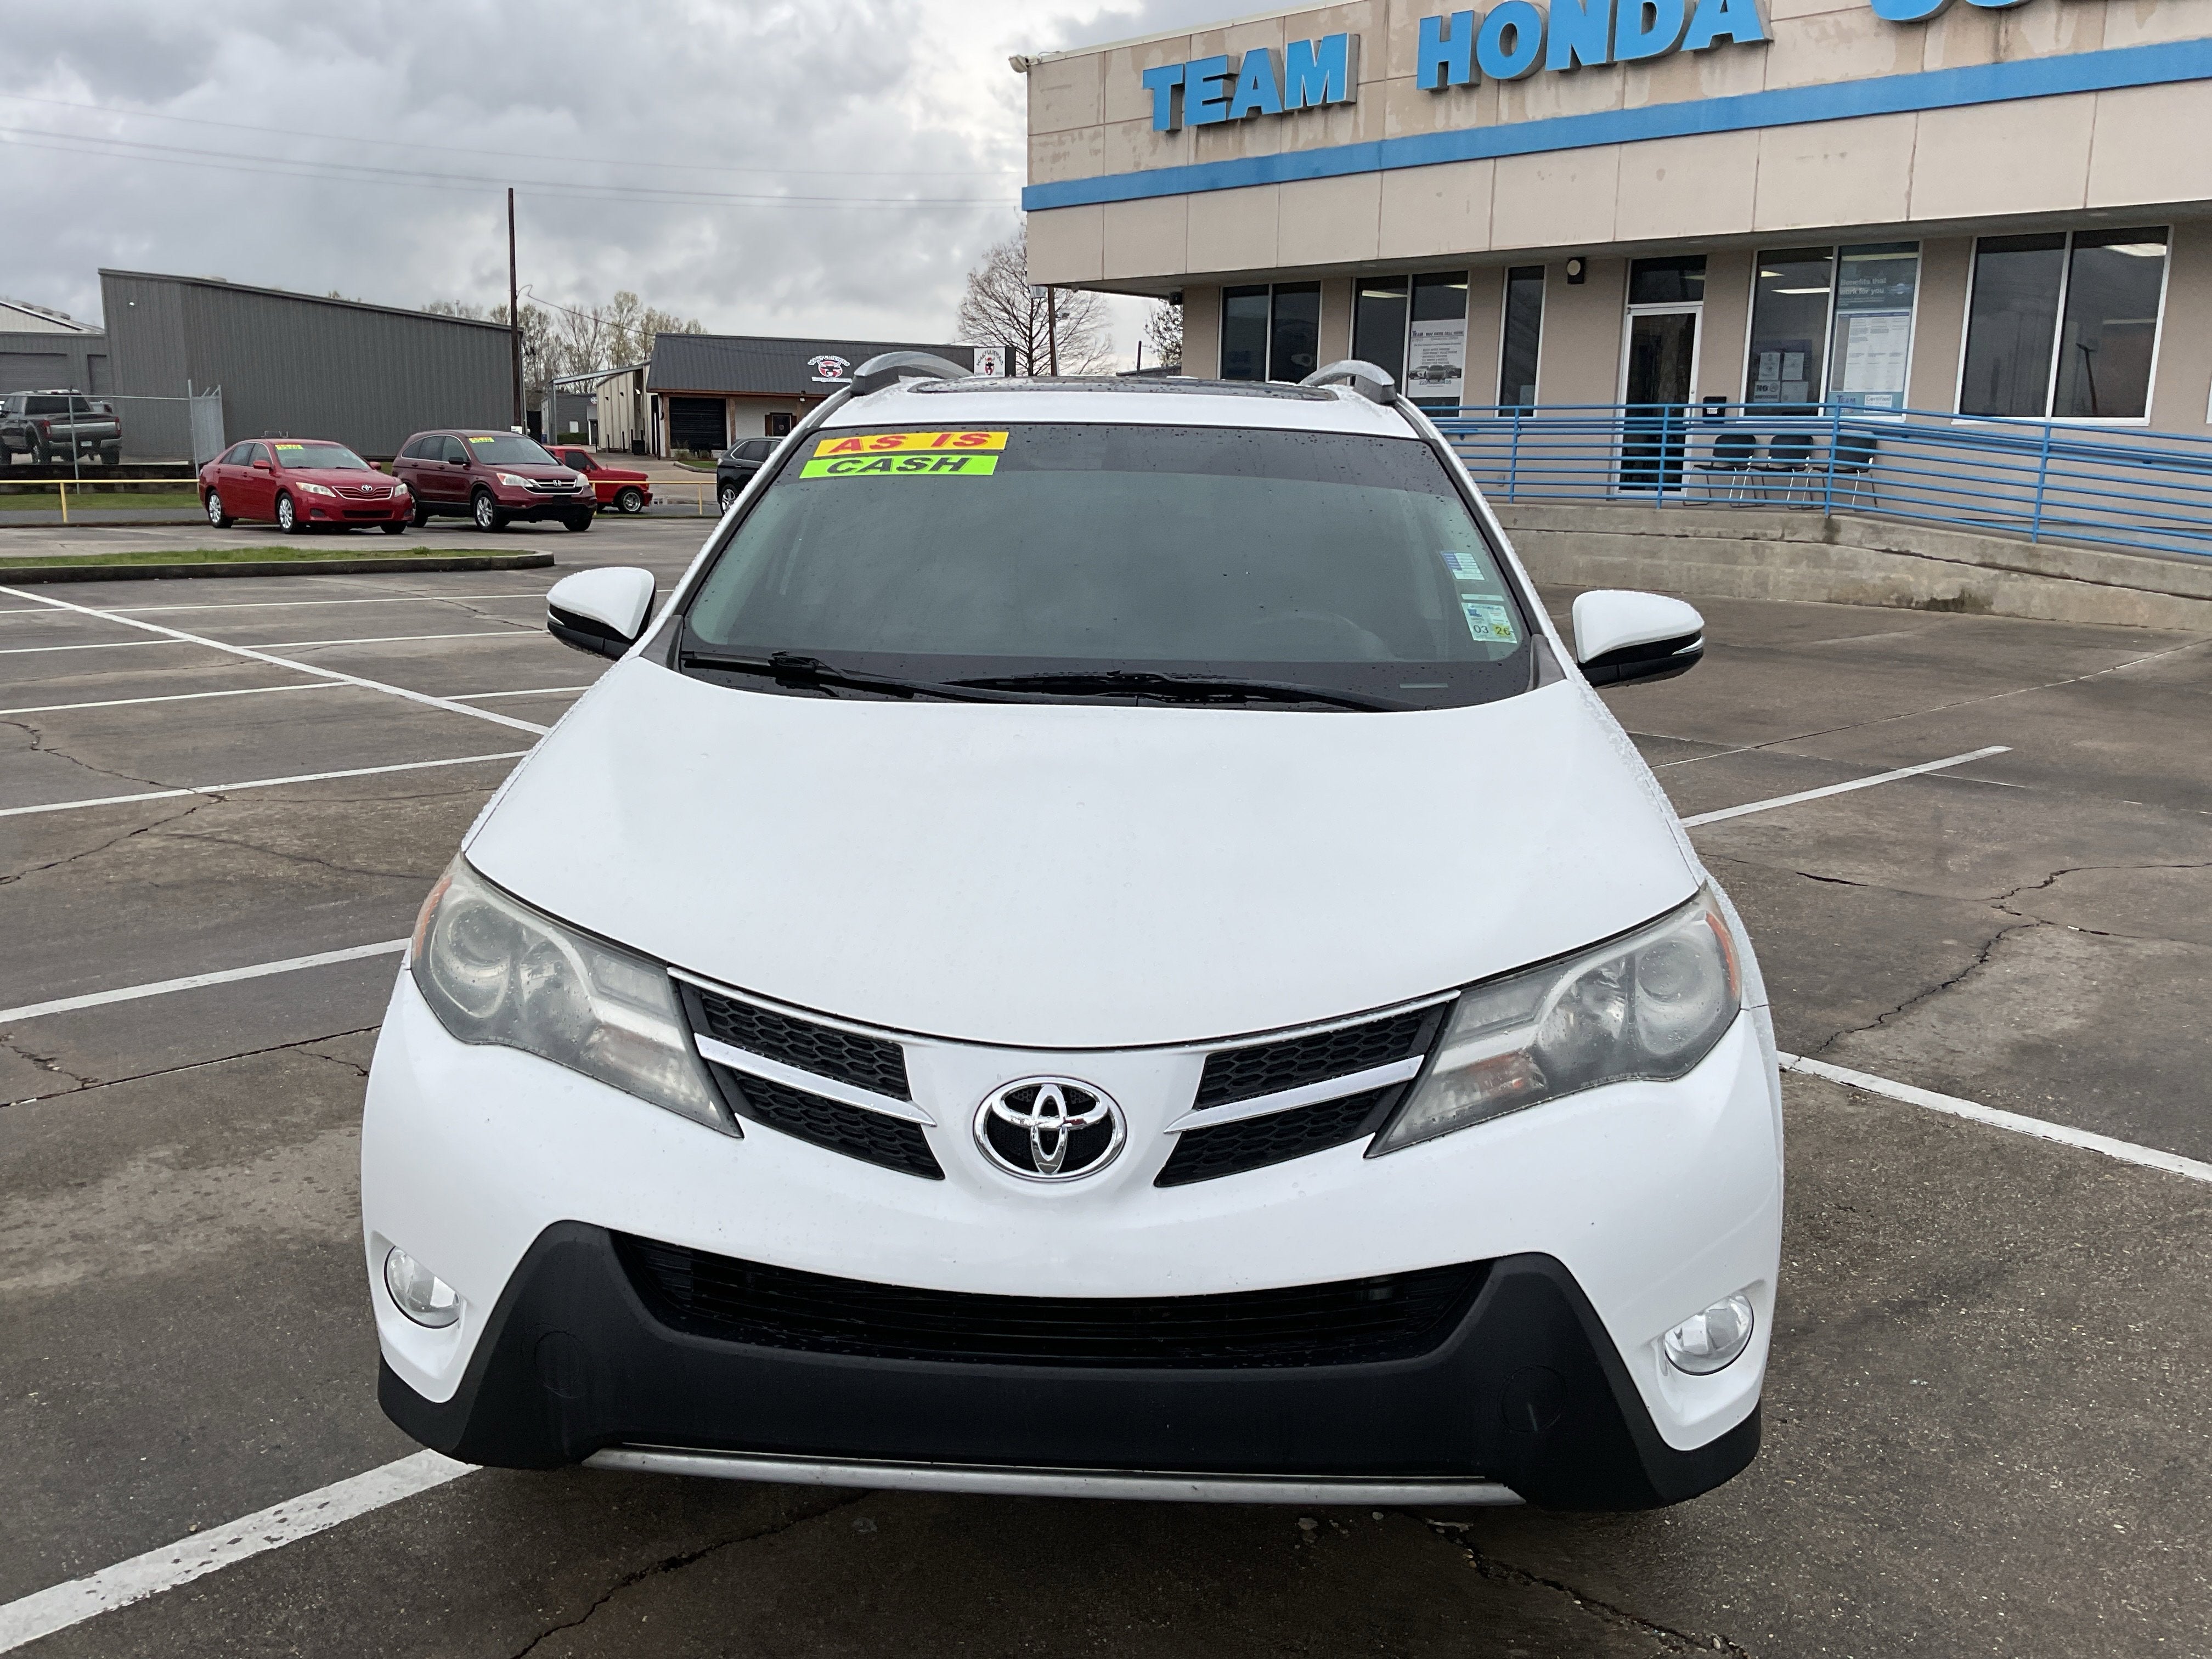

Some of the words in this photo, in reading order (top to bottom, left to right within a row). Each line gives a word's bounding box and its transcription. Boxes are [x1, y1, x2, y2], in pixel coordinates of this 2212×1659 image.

[1143, 32, 1356, 132] TEAM
[1417, 0, 1768, 90] HONDA
[1837, 395, 1856, 404] TEAM
[828, 435, 909, 454] AS
[930, 433, 992, 448] IS
[827, 457, 972, 475] CASH
[1474, 625, 1489, 634] 03
[1496, 627, 1511, 635] 26
